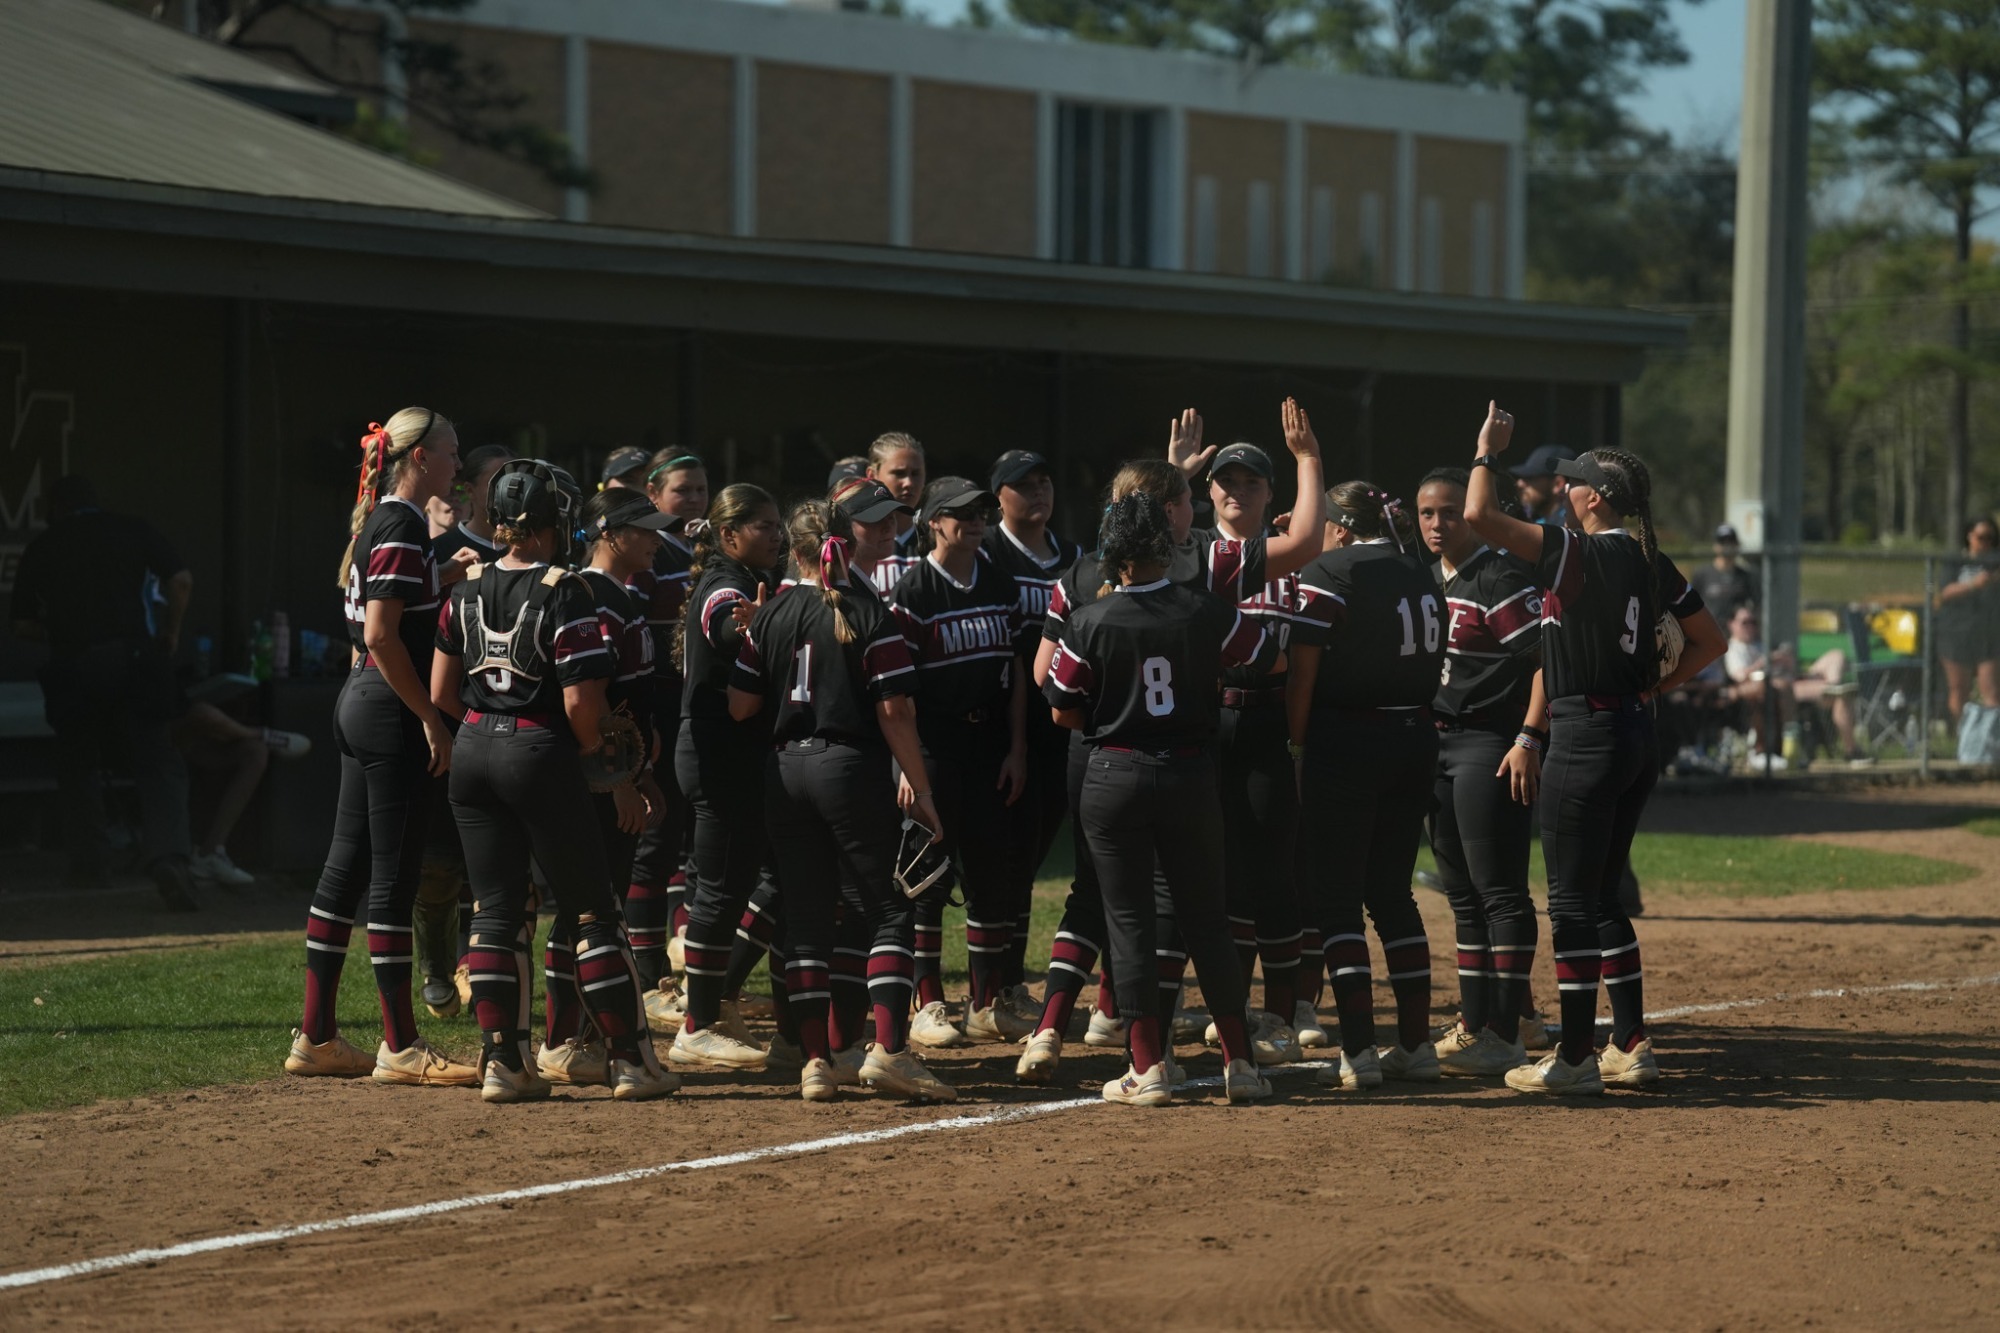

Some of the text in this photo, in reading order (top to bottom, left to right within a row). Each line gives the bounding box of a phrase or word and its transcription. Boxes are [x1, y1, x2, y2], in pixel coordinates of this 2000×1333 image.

[939, 615, 1013, 655] MOBILE
[1397, 593, 1440, 656] 16
[1619, 596, 1640, 655] 9
[790, 643, 812, 704] 1
[1000, 661, 1010, 689] 4
[1142, 655, 1175, 717] 8
[1441, 657, 1452, 686] 3
